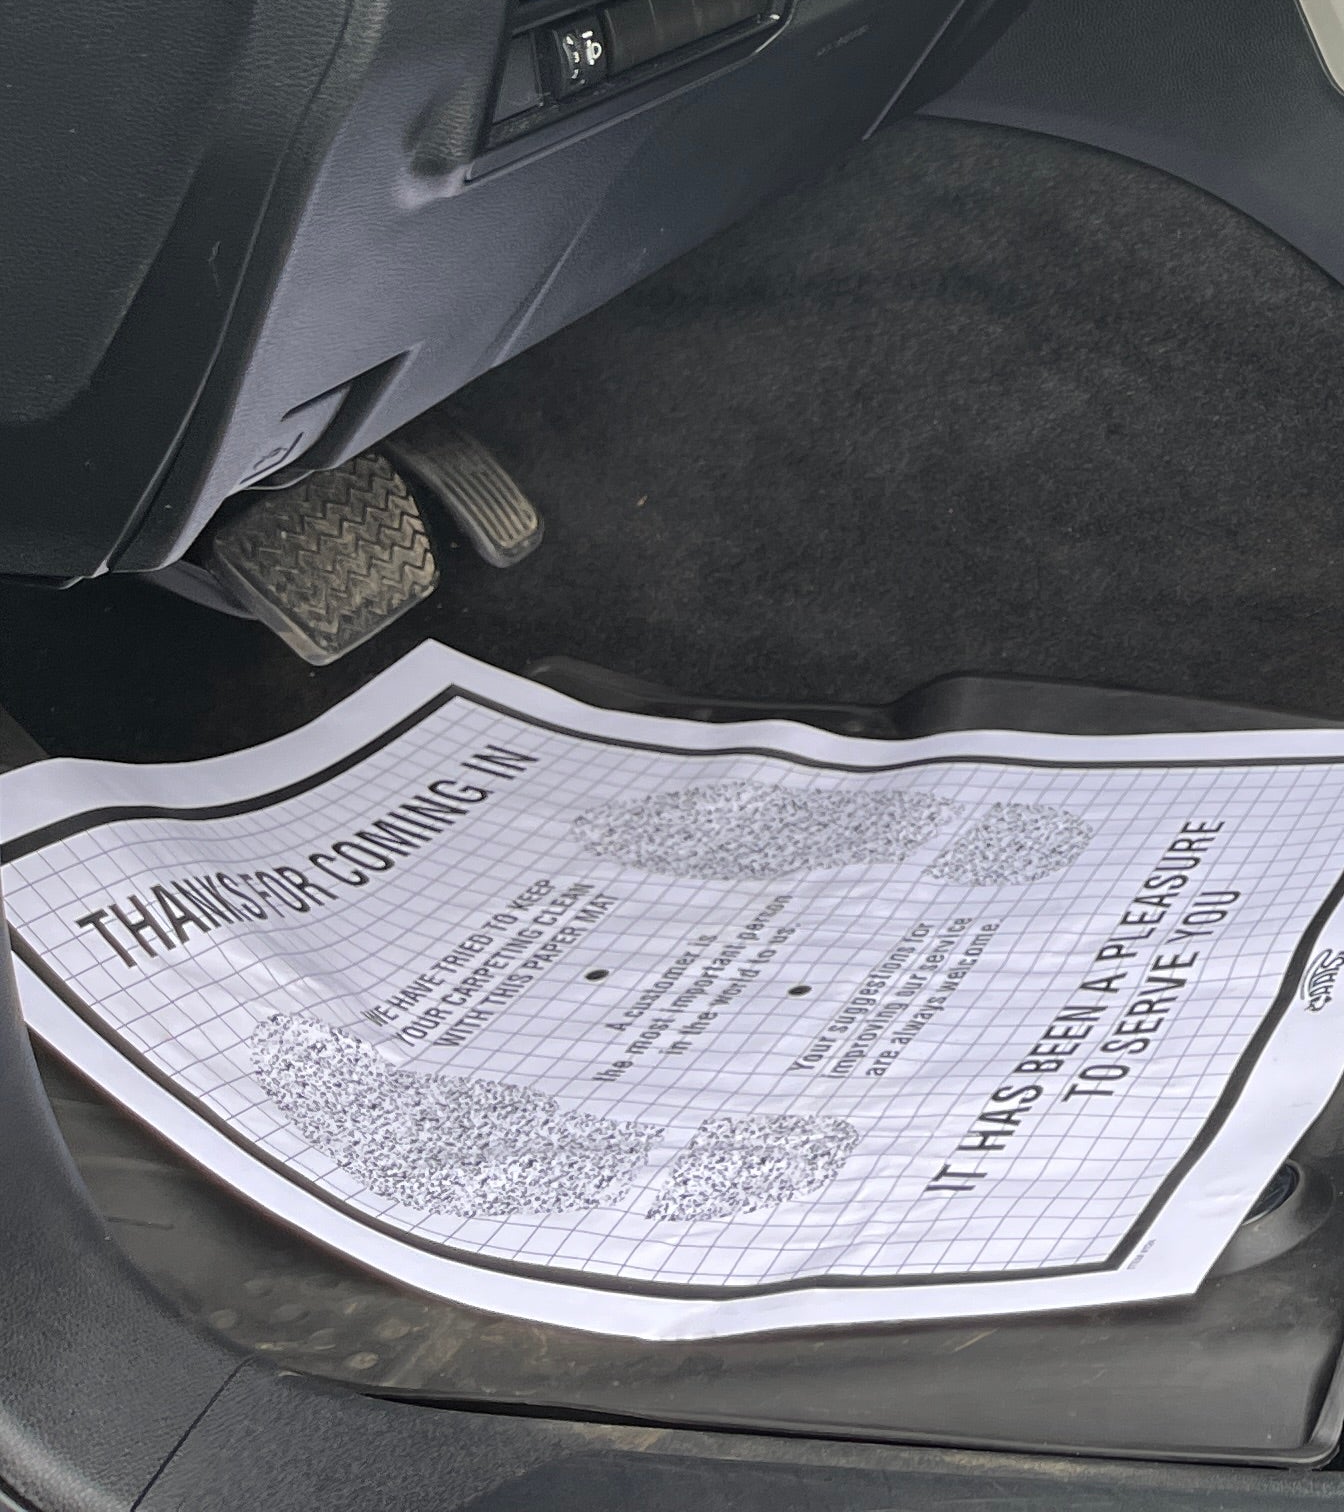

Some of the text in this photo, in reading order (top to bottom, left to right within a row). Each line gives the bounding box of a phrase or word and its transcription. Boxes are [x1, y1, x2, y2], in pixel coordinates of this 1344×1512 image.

[75, 743, 540, 968] THANKS FOR COMING IN
[361, 879, 555, 1027] WE HAVE TRIED TO KEEP
[391, 882, 595, 1047] YOUR CARPETING CLEAN
[433, 893, 619, 1048] WITH THIS PAPER MAT
[592, 894, 793, 1082] the most important person
[605, 1022, 632, 1032] A
[624, 951, 703, 1019] customer
[658, 1040, 692, 1055] in
[679, 1011, 718, 1035] the
[709, 968, 761, 1007] world
[747, 949, 777, 964] to
[789, 922, 934, 1072] Your suggestions for
[820, 918, 973, 1079] improving our service
[924, 820, 1226, 1192] IT HAS BEEN A PLEASURE
[1061, 890, 1241, 1103] TO SERVE YOU
[865, 1050, 901, 1077] are
[890, 996, 949, 1045] always
